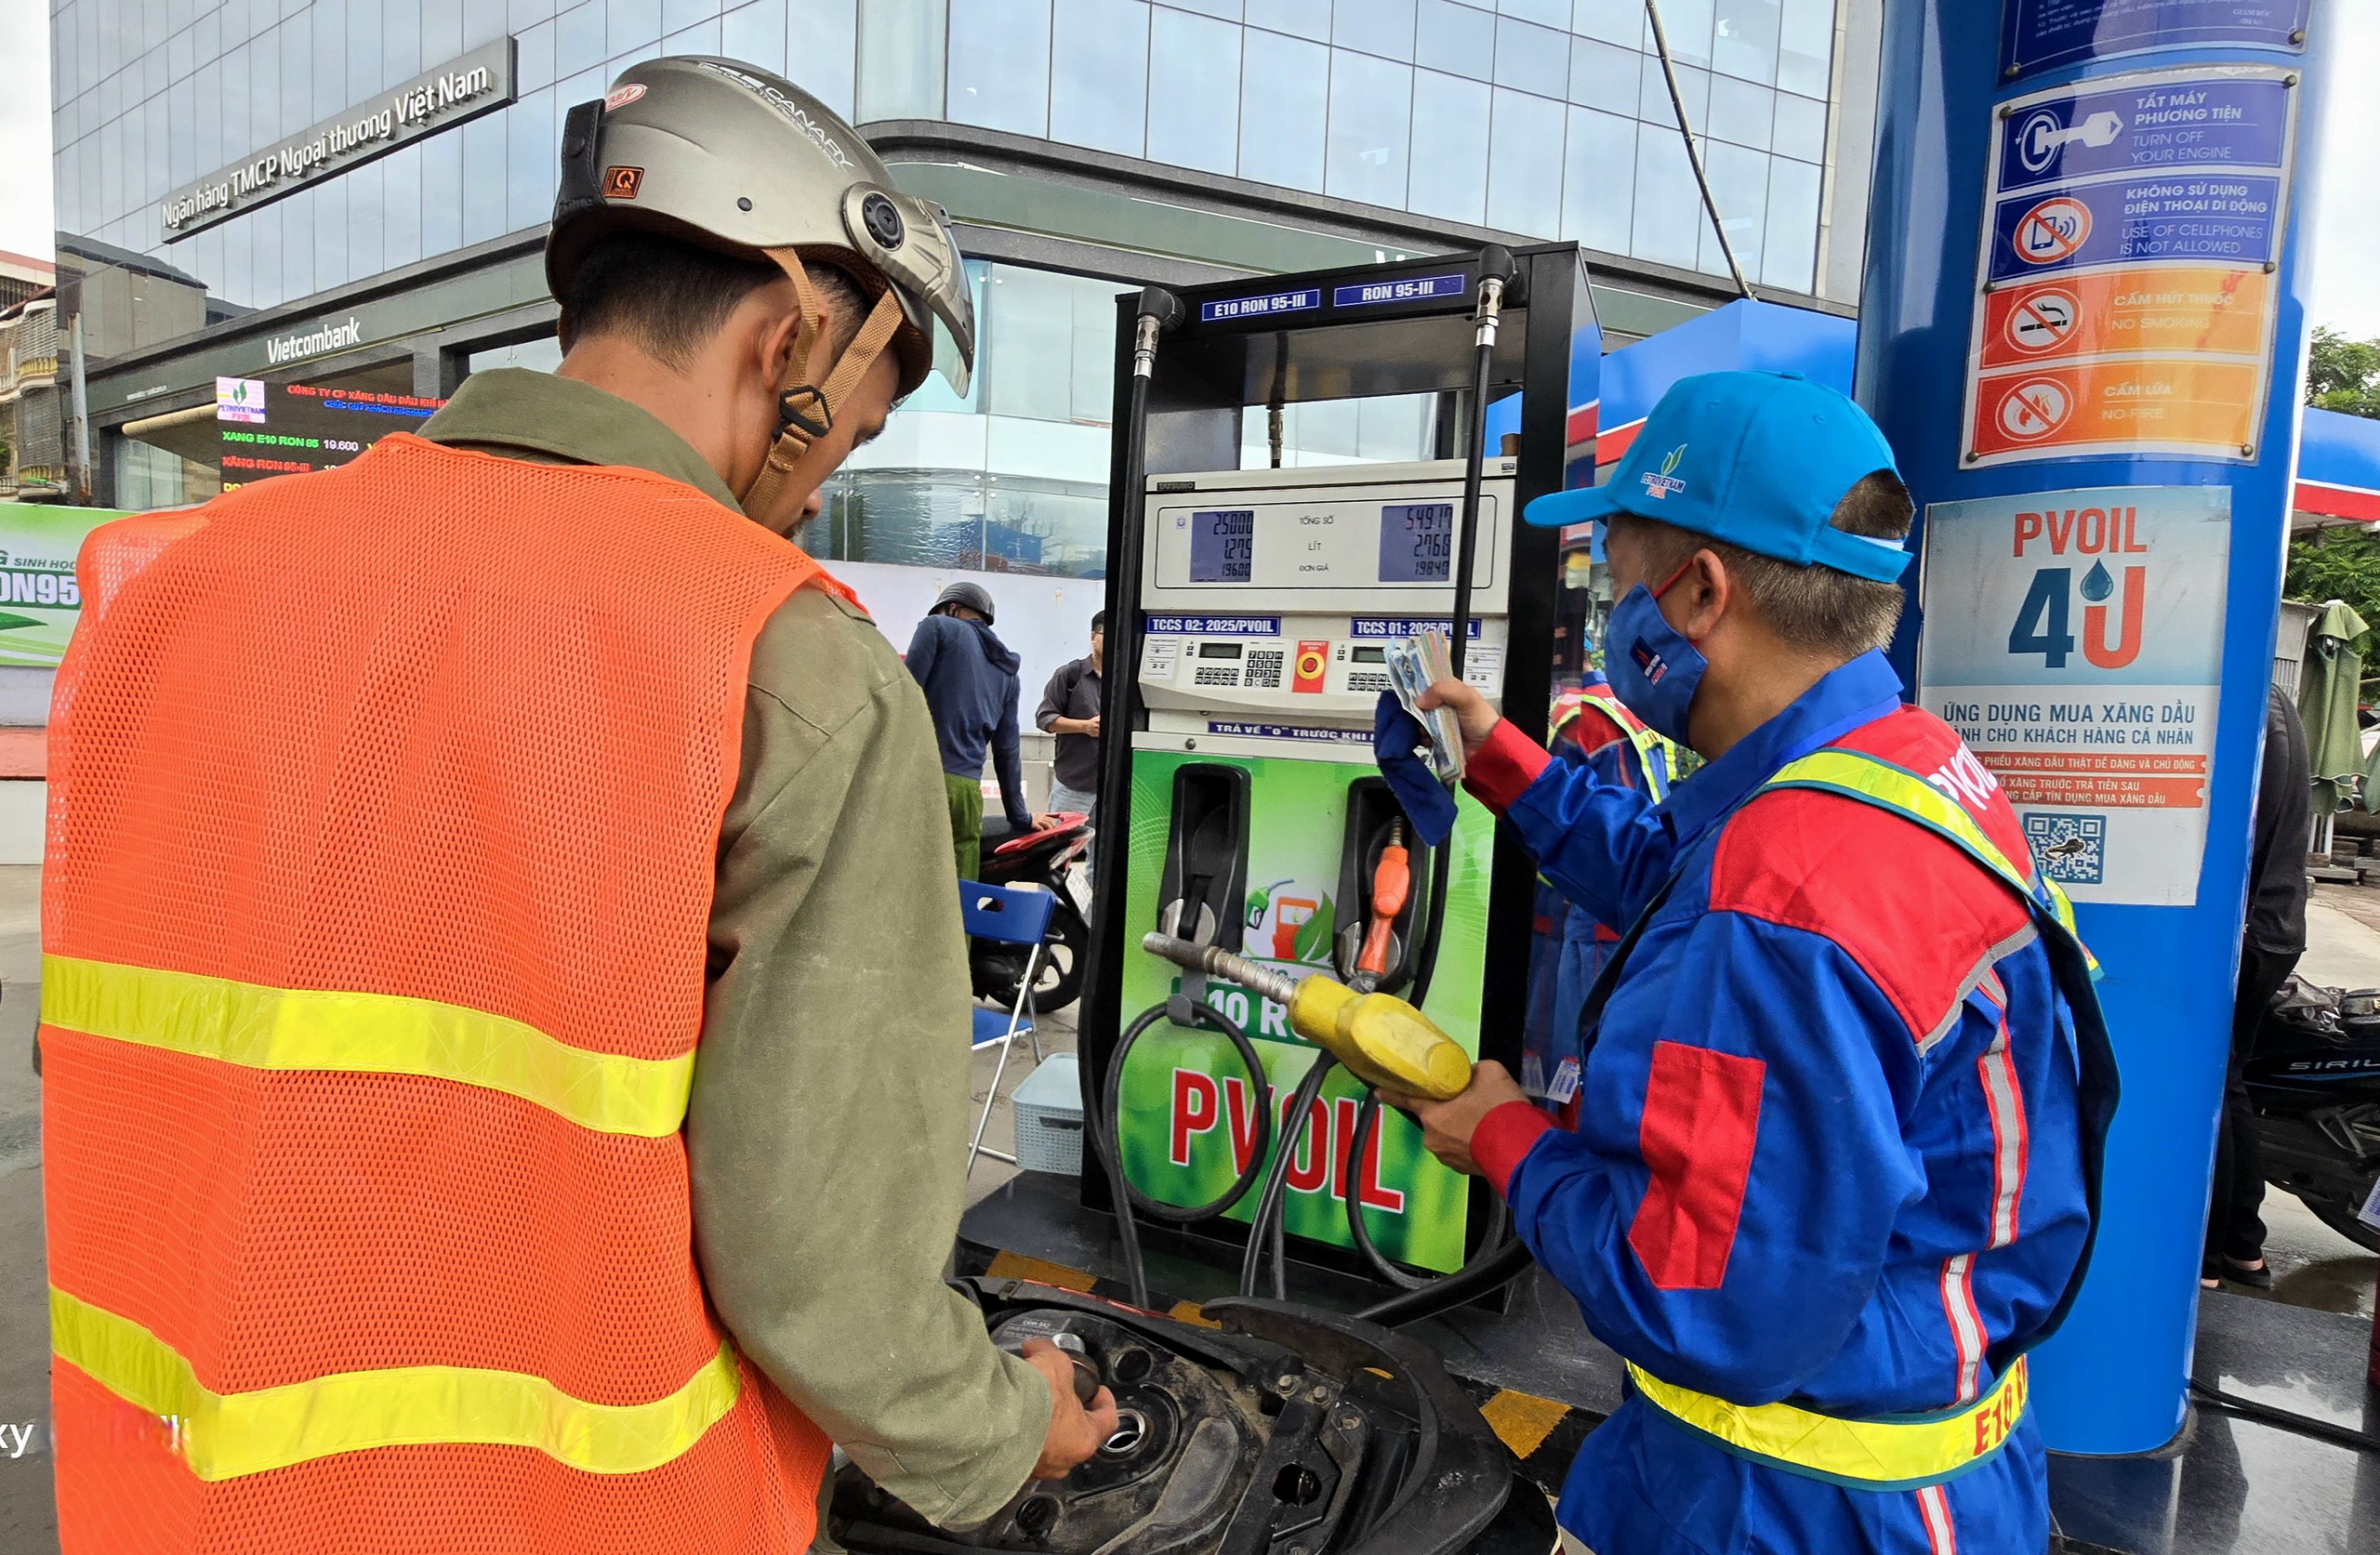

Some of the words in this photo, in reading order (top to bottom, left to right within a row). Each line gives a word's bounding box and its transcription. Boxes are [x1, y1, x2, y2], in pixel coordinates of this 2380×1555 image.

[2136, 91, 2165, 110] TẮT
[2170, 90, 2207, 106] MÁY
[2135, 108, 2208, 125] PHƯƠNG
[2212, 105, 2241, 122] TIỆN
[765, 86, 854, 173] CANARY
[163, 194, 194, 228] Ngân
[196, 183, 229, 213] hàng
[231, 154, 278, 196] TMCP
[281, 132, 326, 176] Ngoại
[330, 109, 391, 153] thương
[395, 85, 434, 124] Việt
[439, 66, 487, 107] Nam
[2133, 132, 2172, 147] TURN
[2175, 131, 2204, 143] OFF
[2131, 149, 2174, 163] YOUR
[2177, 147, 2232, 160] ENGINE
[2126, 184, 2184, 200] KHÔNG
[2188, 181, 2207, 196] SỬ
[2209, 185, 2248, 199] DỤNG
[2124, 199, 2159, 216] ĐIỆN
[2163, 200, 2208, 213] THOẠI
[2212, 201, 2226, 211] DI
[2229, 199, 2268, 215] ĐỘNG
[2122, 227, 2149, 240] USE
[2153, 225, 2175, 237] OF
[2179, 224, 2263, 239] CELLPHONES
[2120, 244, 2132, 255] IS
[2135, 241, 2169, 254] NOT
[2172, 241, 2241, 253] ALLOWED
[1362, 284, 1392, 301] RON
[1395, 281, 1434, 297] 95-III
[2114, 290, 2151, 306] CẤM
[1214, 301, 1238, 317] E10
[1241, 298, 1268, 314] RON
[1271, 294, 1306, 310] 95-III
[2111, 319, 2135, 330] NO
[2139, 317, 2210, 329] SMOKING
[267, 317, 361, 363] Vietcombank
[332, 389, 346, 399] CP
[2105, 381, 2140, 397] CẤM
[2102, 408, 2125, 420] NO
[257, 434, 276, 444] E10
[279, 436, 304, 447] RON
[306, 439, 319, 448] 95
[324, 440, 359, 452] 19.600
[257, 459, 283, 471] RON
[1213, 513, 1253, 535] 25000
[2013, 507, 2148, 558] PVOIL
[1308, 540, 1321, 550] LÍT
[14, 558, 46, 568] SINH
[1222, 562, 1250, 577] 19600
[1415, 560, 1449, 575] 19840
[0, 572, 80, 605] ON95
[1153, 619, 1183, 631] TCCS
[1184, 619, 1203, 631] 02:
[1206, 620, 1274, 632] 2025/PVOIL
[1356, 622, 1386, 634] TCCS
[1388, 622, 1407, 635] 01:
[1944, 701, 1979, 722] ỨNG
[1988, 704, 2041, 725] DỤNG
[2049, 705, 2093, 722] MUA
[2102, 702, 2153, 723] XĂNG
[2162, 699, 2195, 723] DẦU
[1216, 723, 1241, 733] TRẢ
[1291, 728, 1338, 739] TRƯỚC
[1342, 731, 1367, 741] KHI
[1955, 725, 1980, 742] ÀNH
[1987, 728, 2017, 742] CHO
[2025, 727, 2080, 744] KHÁCH
[2083, 727, 2125, 745] HÀNG
[2132, 727, 2151, 745] CÁ
[2157, 729, 2193, 745] NHÂN
[1985, 754, 2011, 766] PHIẾU
[2015, 756, 2041, 768] XĂNG
[2044, 755, 2065, 768] DẦU
[2109, 756, 2135, 769] DÀNG
[2138, 756, 2150, 769] VÀ
[2153, 757, 2170, 770] CHỦ
[2174, 758, 2195, 771] ĐỘNG
[2009, 777, 2036, 788] XĂNG
[2040, 778, 2072, 789] TRƯỚC
[2075, 779, 2094, 790] TRẢ
[2097, 778, 2119, 790] TIỀN
[2122, 781, 2139, 791] SAU
[2022, 789, 2043, 800] CẤP
[2065, 793, 2092, 804] DỤNG
[2096, 794, 2116, 804] MUA
[2120, 793, 2145, 805] XĂNG
[2148, 793, 2165, 805] DẦU
[1206, 989, 1249, 1030] 10
[1170, 1067, 1404, 1214] PVOIL
[1974, 1383, 2012, 1456] E10
